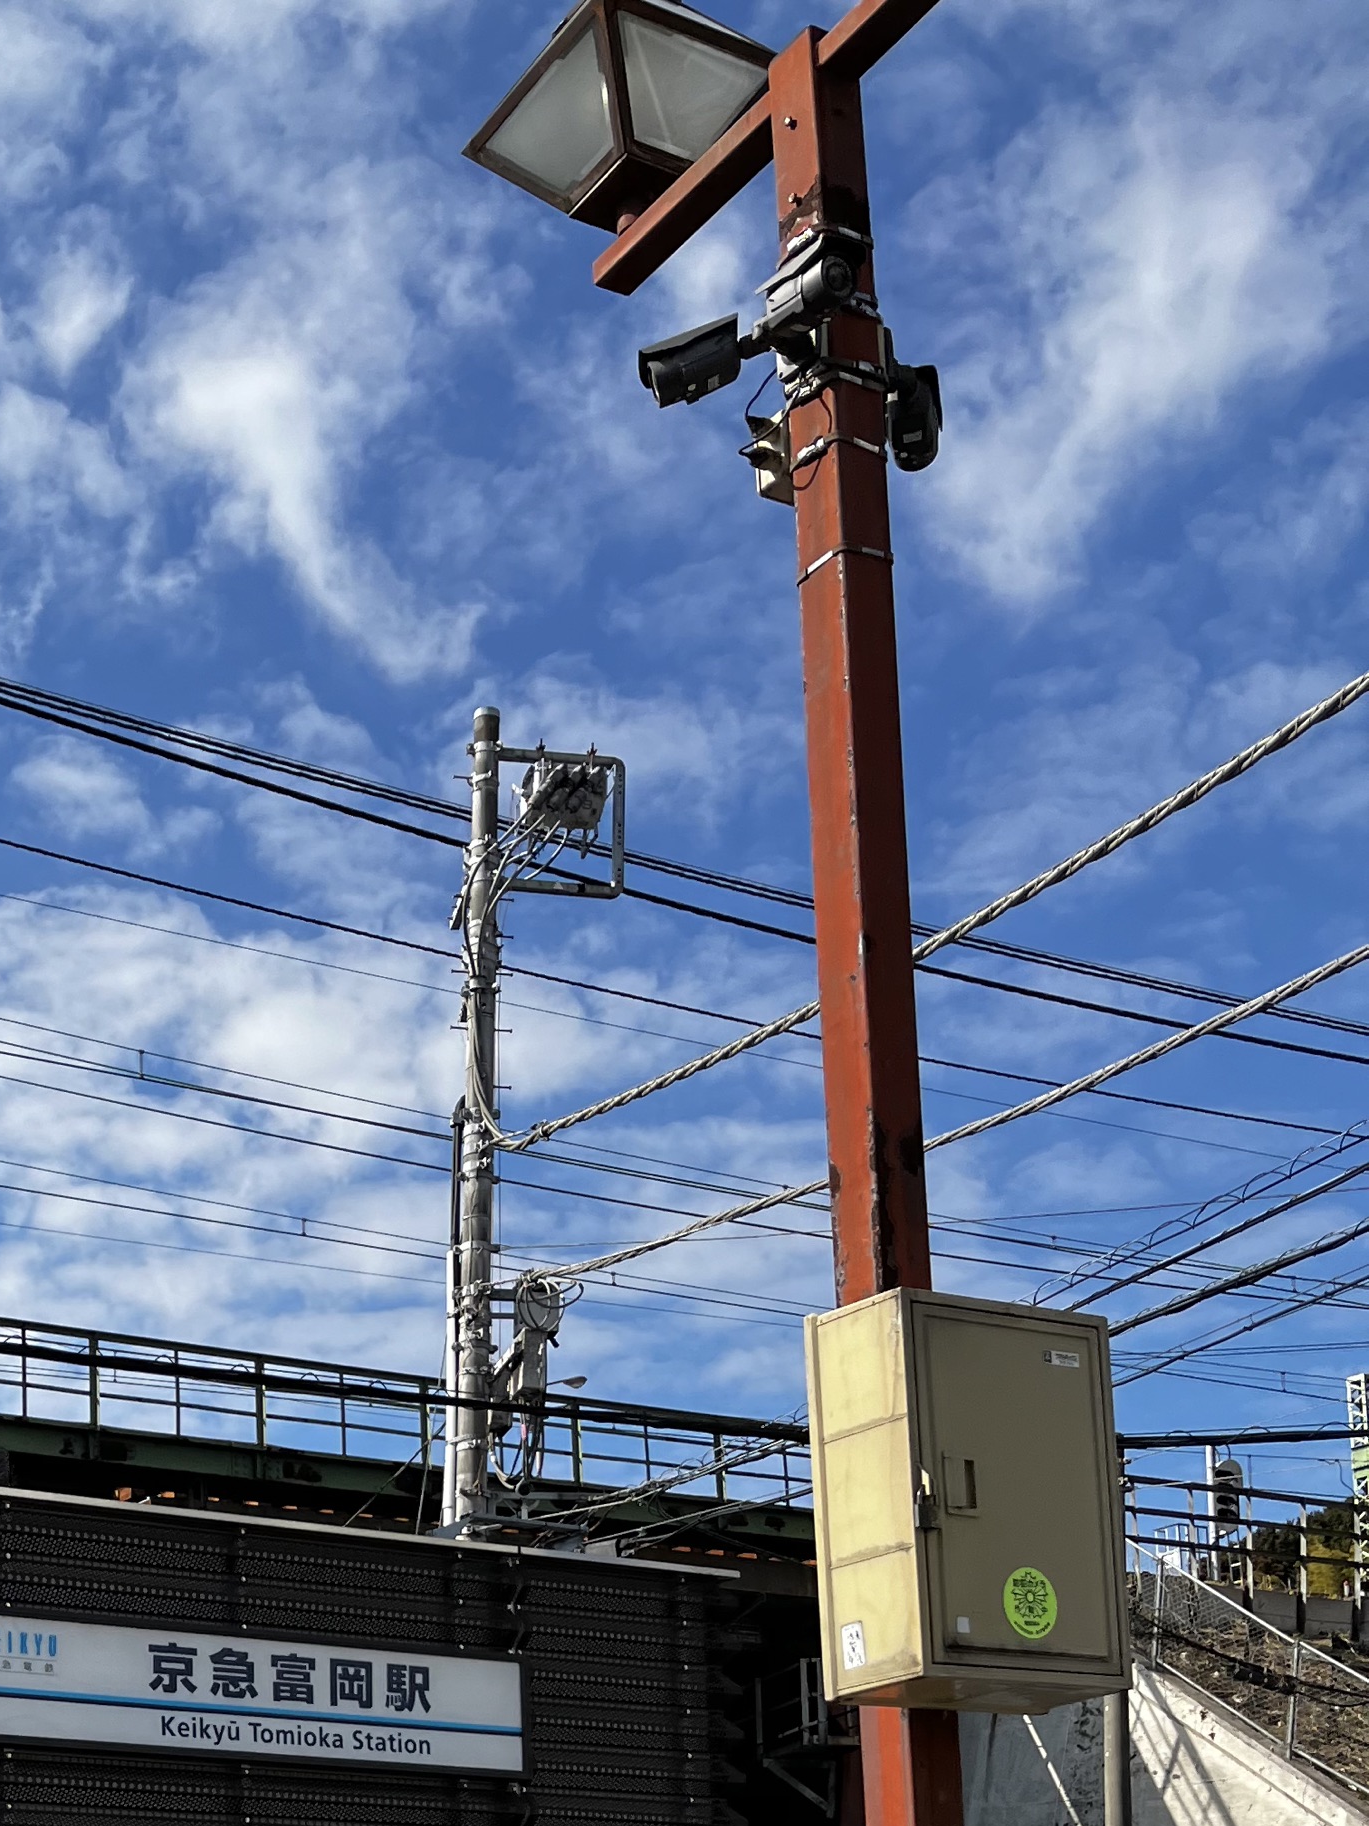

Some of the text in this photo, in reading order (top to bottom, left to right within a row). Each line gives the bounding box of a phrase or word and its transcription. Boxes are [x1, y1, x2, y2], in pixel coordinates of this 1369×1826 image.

[148, 1642, 431, 1713] 京急富岡駅
[160, 1715, 431, 1755] Keikyū Tomioka Station
